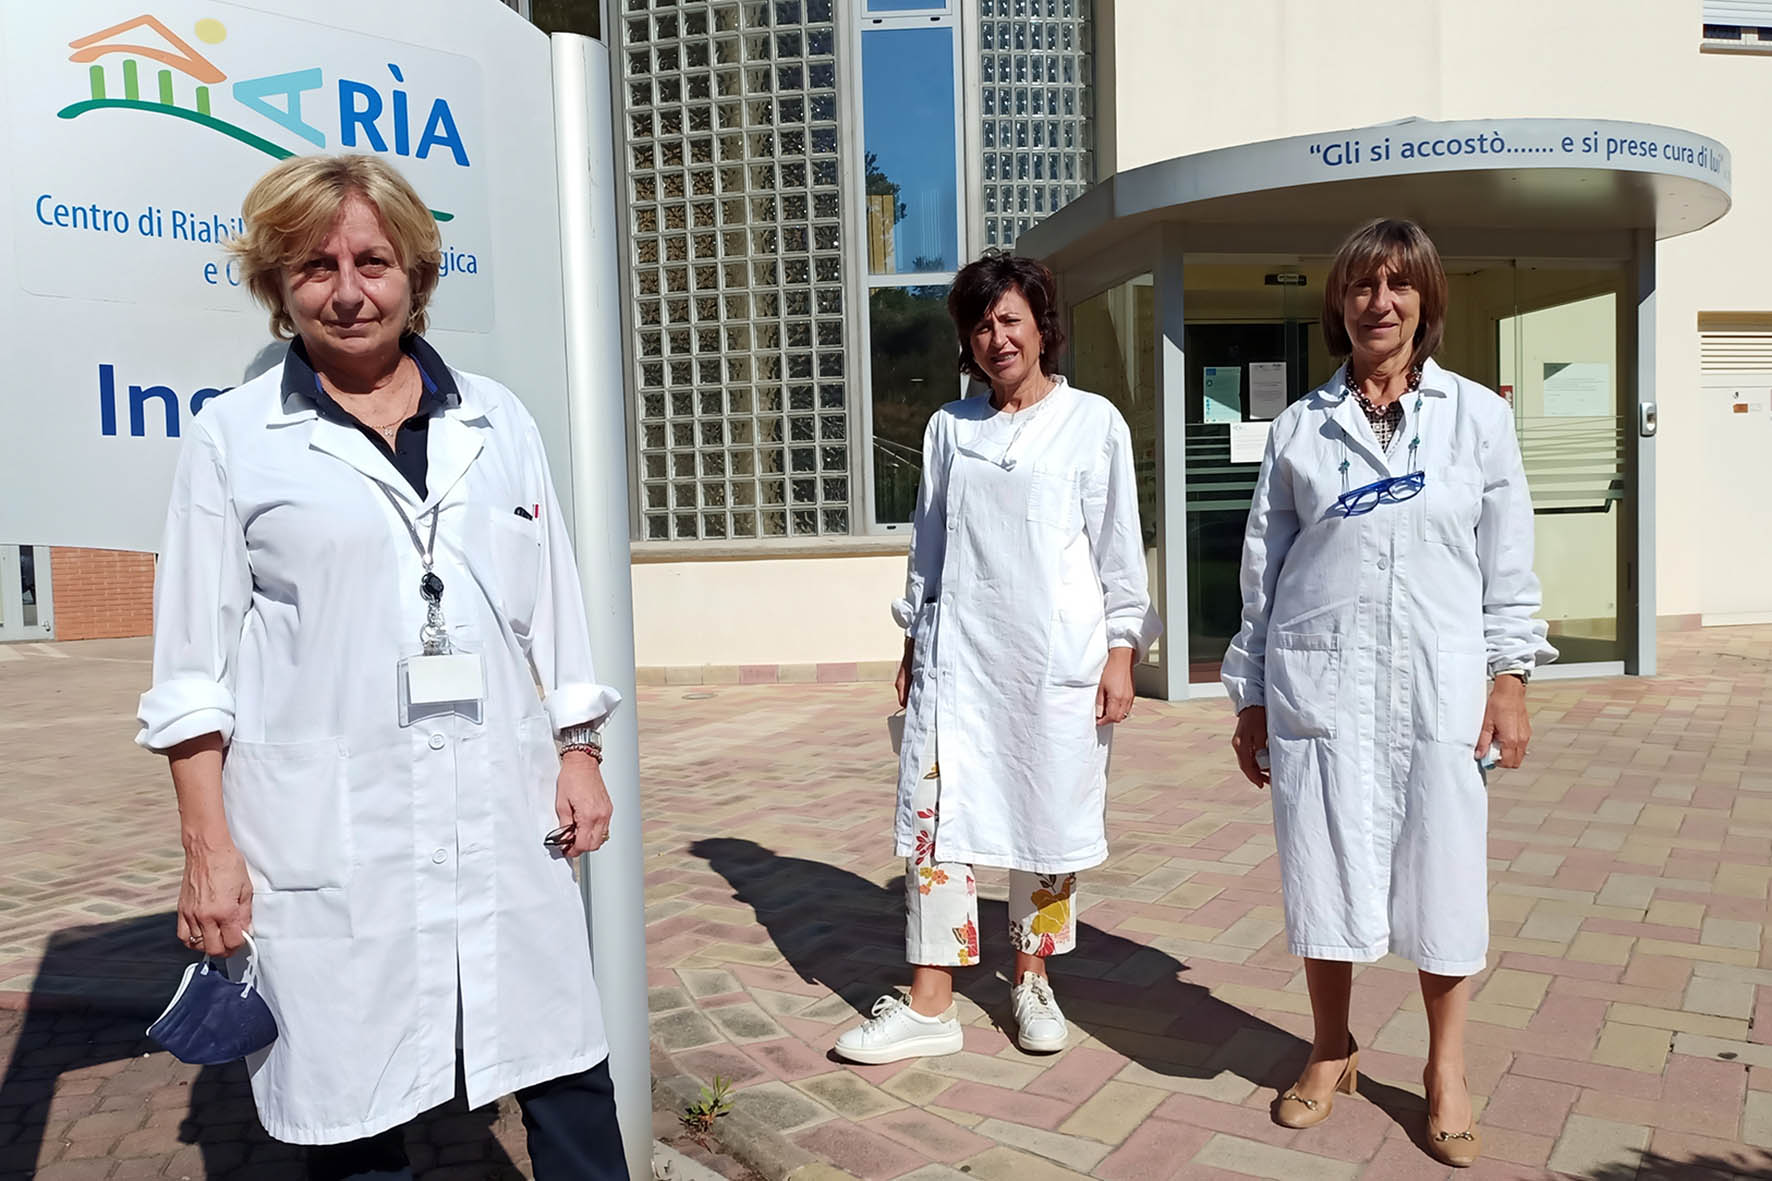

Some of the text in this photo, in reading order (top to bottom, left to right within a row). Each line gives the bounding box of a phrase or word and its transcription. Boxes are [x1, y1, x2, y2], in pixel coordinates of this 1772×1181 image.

[1310, 140, 1361, 167] “Gli
[1369, 137, 1391, 162] si
[1560, 135, 1575, 153] e
[1581, 130, 1599, 153] si
[1606, 136, 1658, 161] prese
[1662, 143, 1695, 164] cura
[1697, 144, 1708, 169] di
[35, 193, 478, 278] Centro di Riabil gica
[203, 262, 219, 285] e
